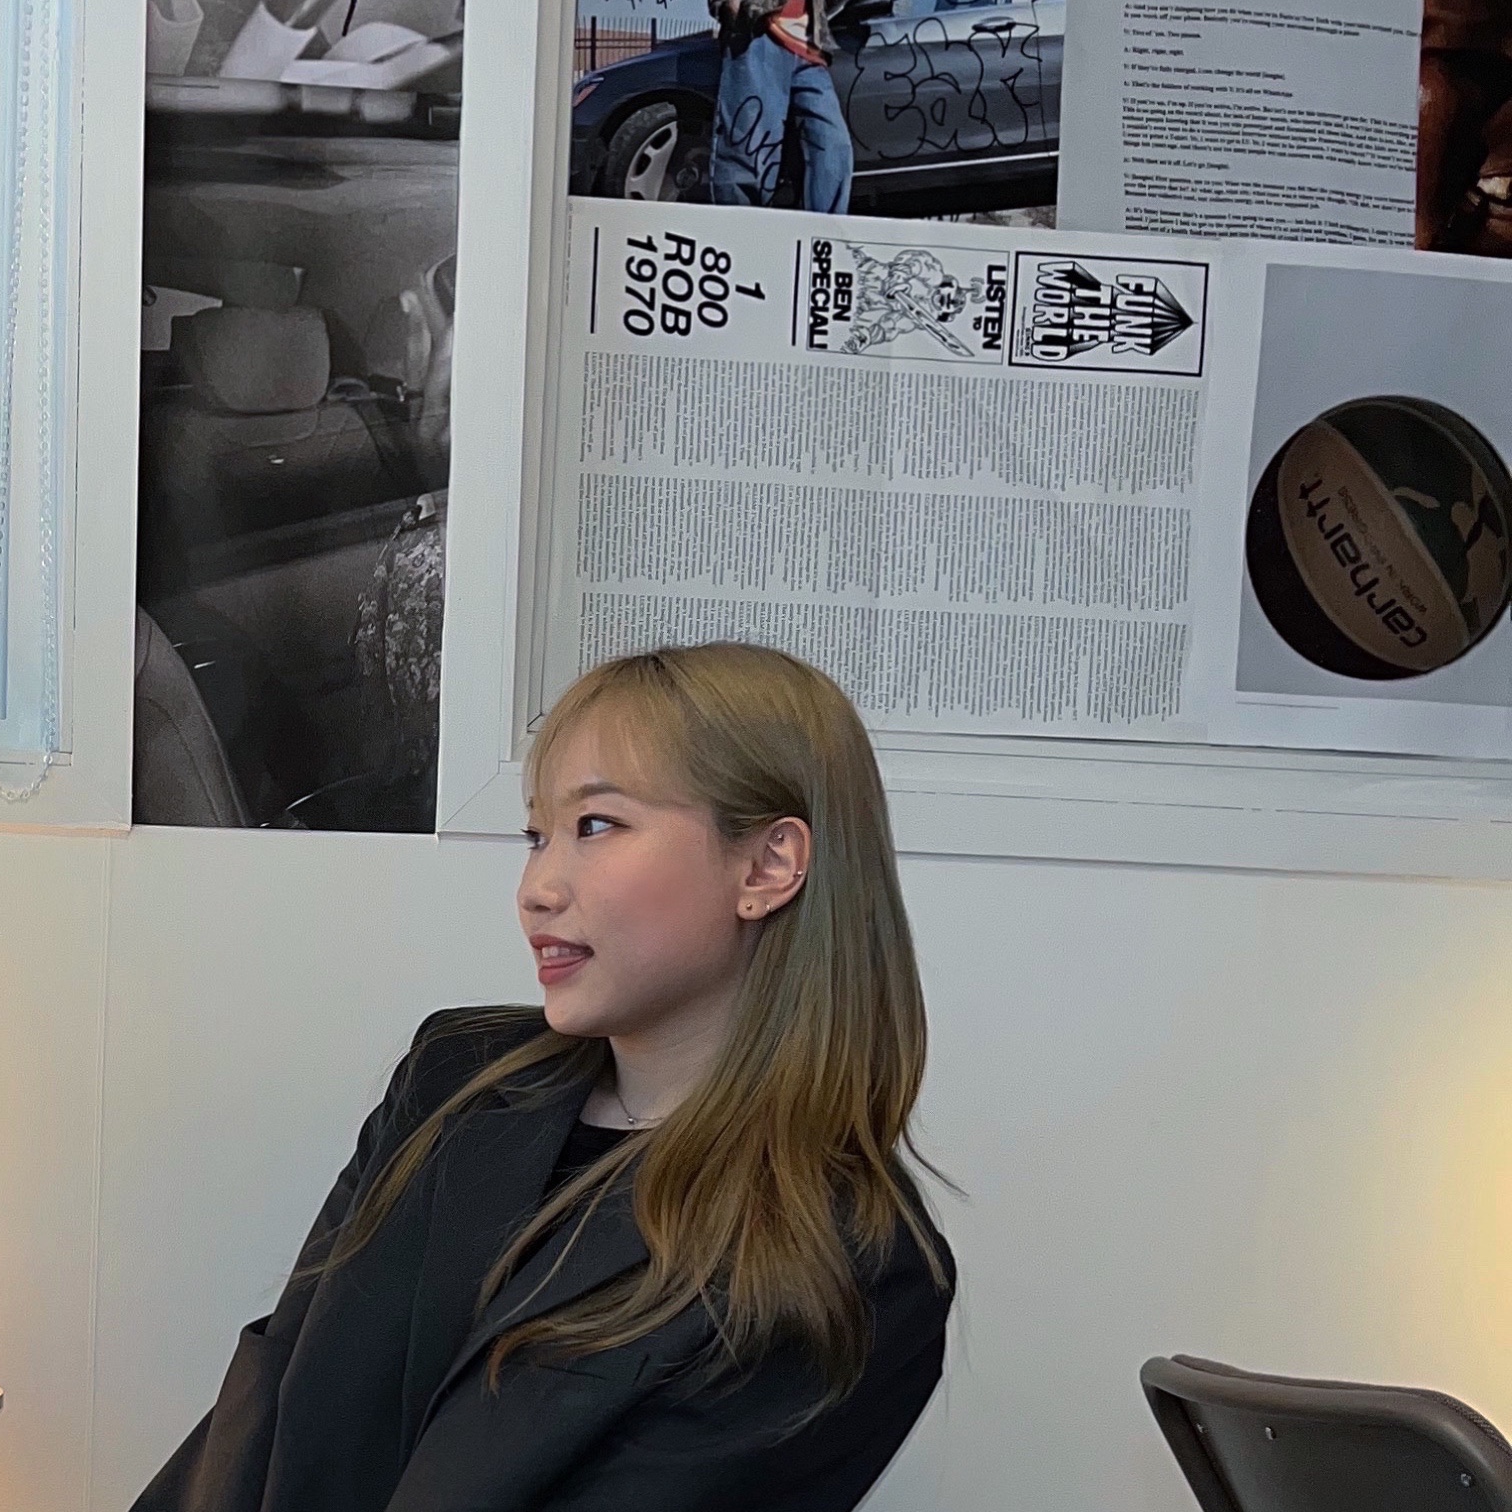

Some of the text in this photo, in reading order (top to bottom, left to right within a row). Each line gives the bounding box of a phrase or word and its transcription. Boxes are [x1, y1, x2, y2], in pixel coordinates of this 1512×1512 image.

[623, 235, 658, 337] 1970
[661, 232, 695, 337] ROB
[697, 246, 731, 329] 800
[735, 282, 766, 300] 1
[809, 239, 832, 350] SPECIAL!
[833, 271, 852, 322] BEN
[973, 315, 982, 331] TO
[983, 264, 1007, 350] LISTEN
[1031, 261, 1074, 362] WORLD
[1072, 285, 1111, 342] THE
[1112, 275, 1157, 355] FUNK
[1298, 478, 1427, 648] carhartt
